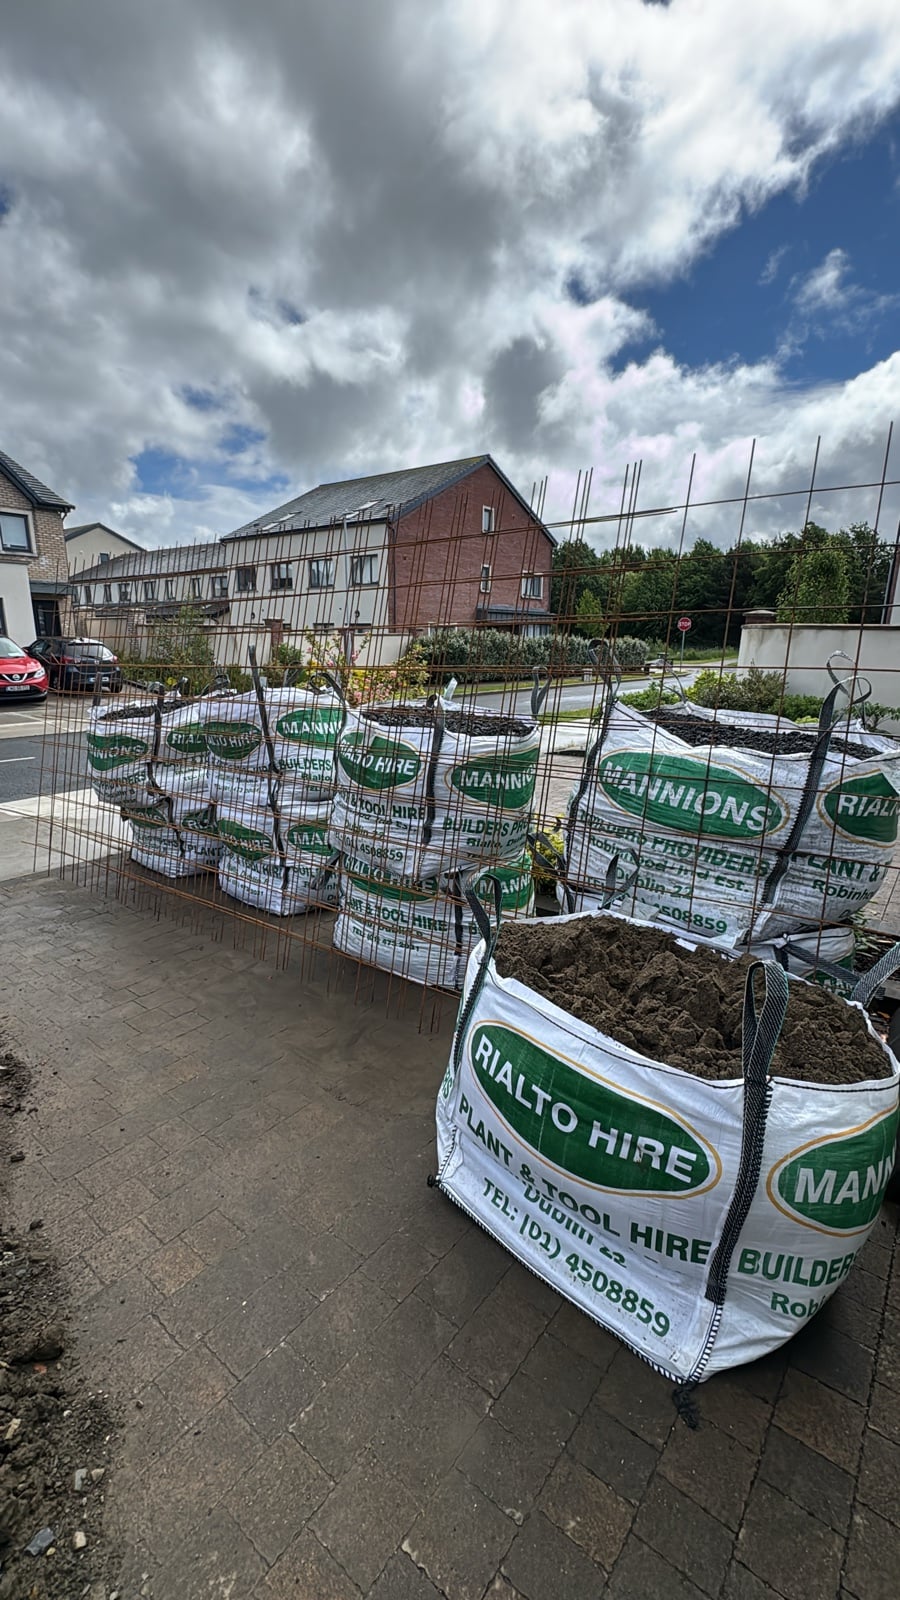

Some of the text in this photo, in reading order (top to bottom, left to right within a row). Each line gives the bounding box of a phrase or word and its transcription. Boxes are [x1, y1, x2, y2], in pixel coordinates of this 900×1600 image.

[278, 758, 333, 771] BUILDERS
[375, 756, 417, 776] HIRE
[602, 760, 774, 832] MANNIONS
[391, 805, 426, 820] HIRE
[442, 816, 509, 837] BUILDERS
[651, 836, 771, 877] PROVIDERS
[670, 884, 693, 900] 22
[715, 874, 751, 892] Est.
[412, 912, 448, 932] HIRE
[474, 1033, 698, 1184] RIALTO HIRE
[458, 1092, 713, 1266] PLANT & TOOL HIRE
[483, 1176, 671, 1338] TEL: (01) 4508859
[737, 1247, 858, 1288] BUILDER
